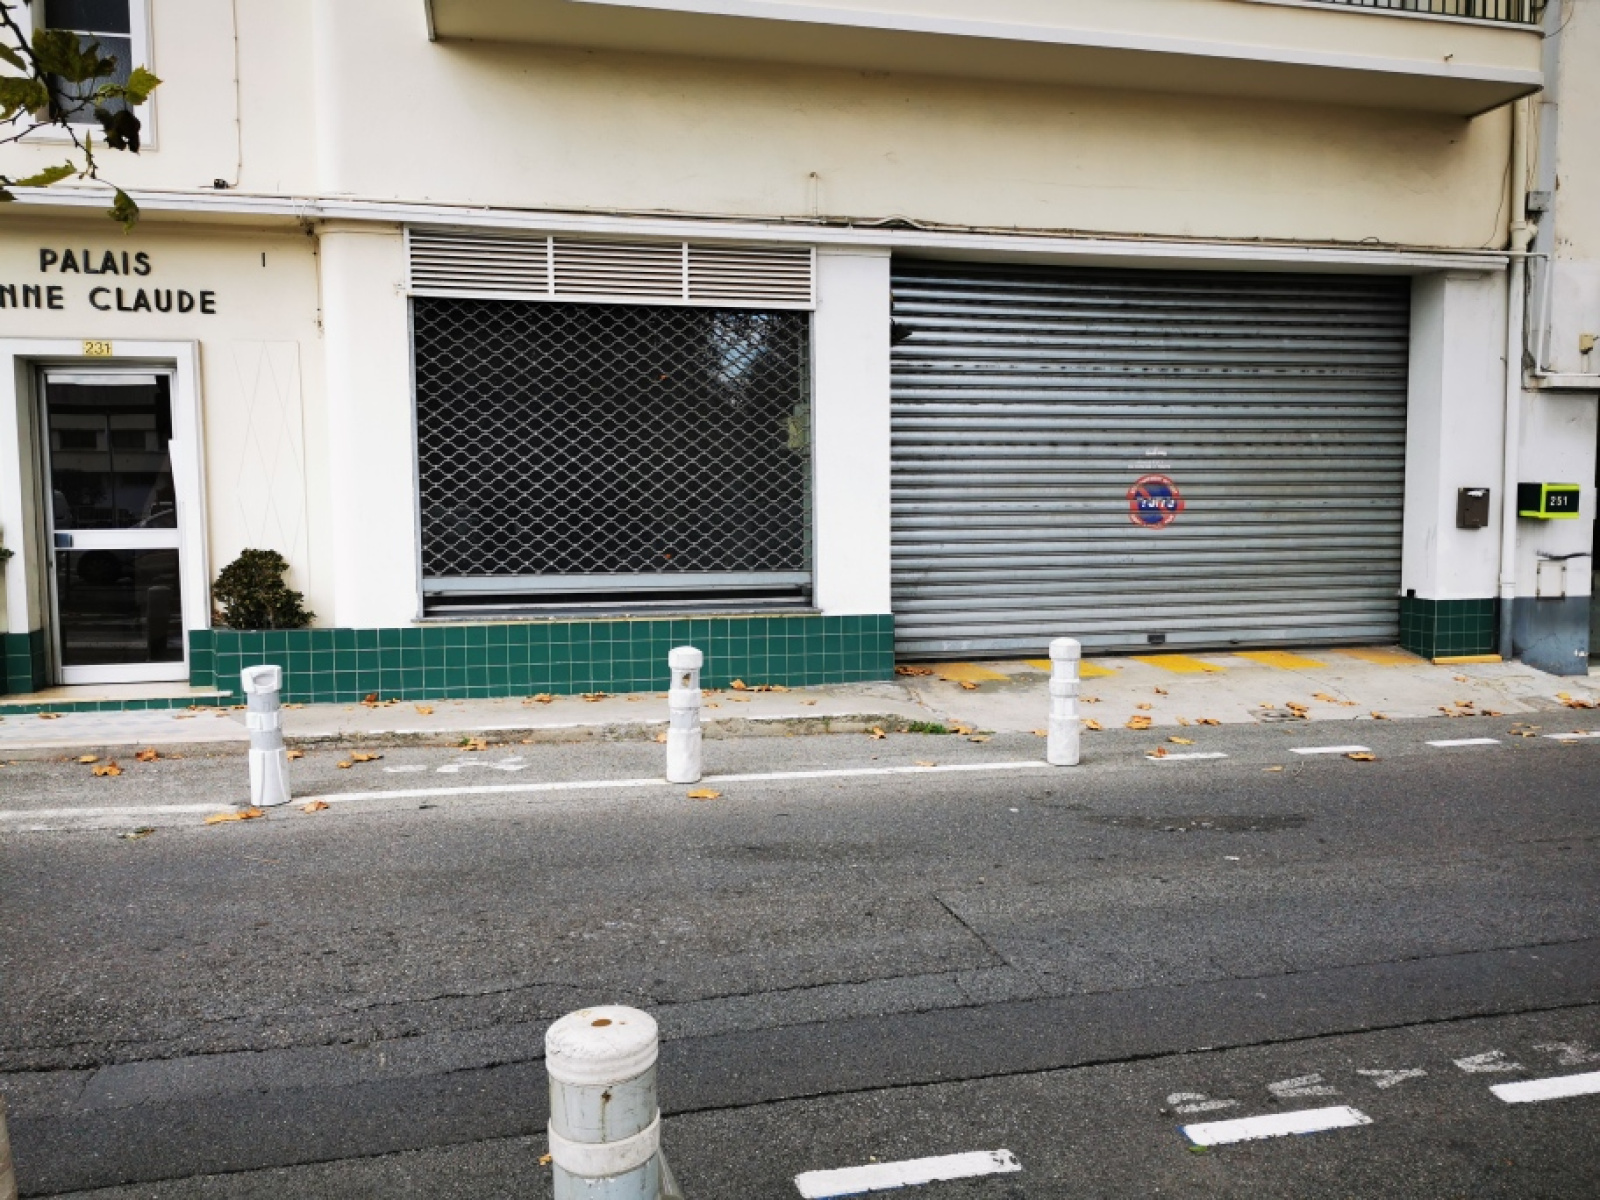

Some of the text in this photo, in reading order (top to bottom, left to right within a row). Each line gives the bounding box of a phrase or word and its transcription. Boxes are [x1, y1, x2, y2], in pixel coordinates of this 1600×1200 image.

[39, 248, 151, 276] PALAIS
[88, 286, 216, 314] CLAUDE
[85, 341, 110, 355] 231
[1550, 495, 1568, 507] 251
